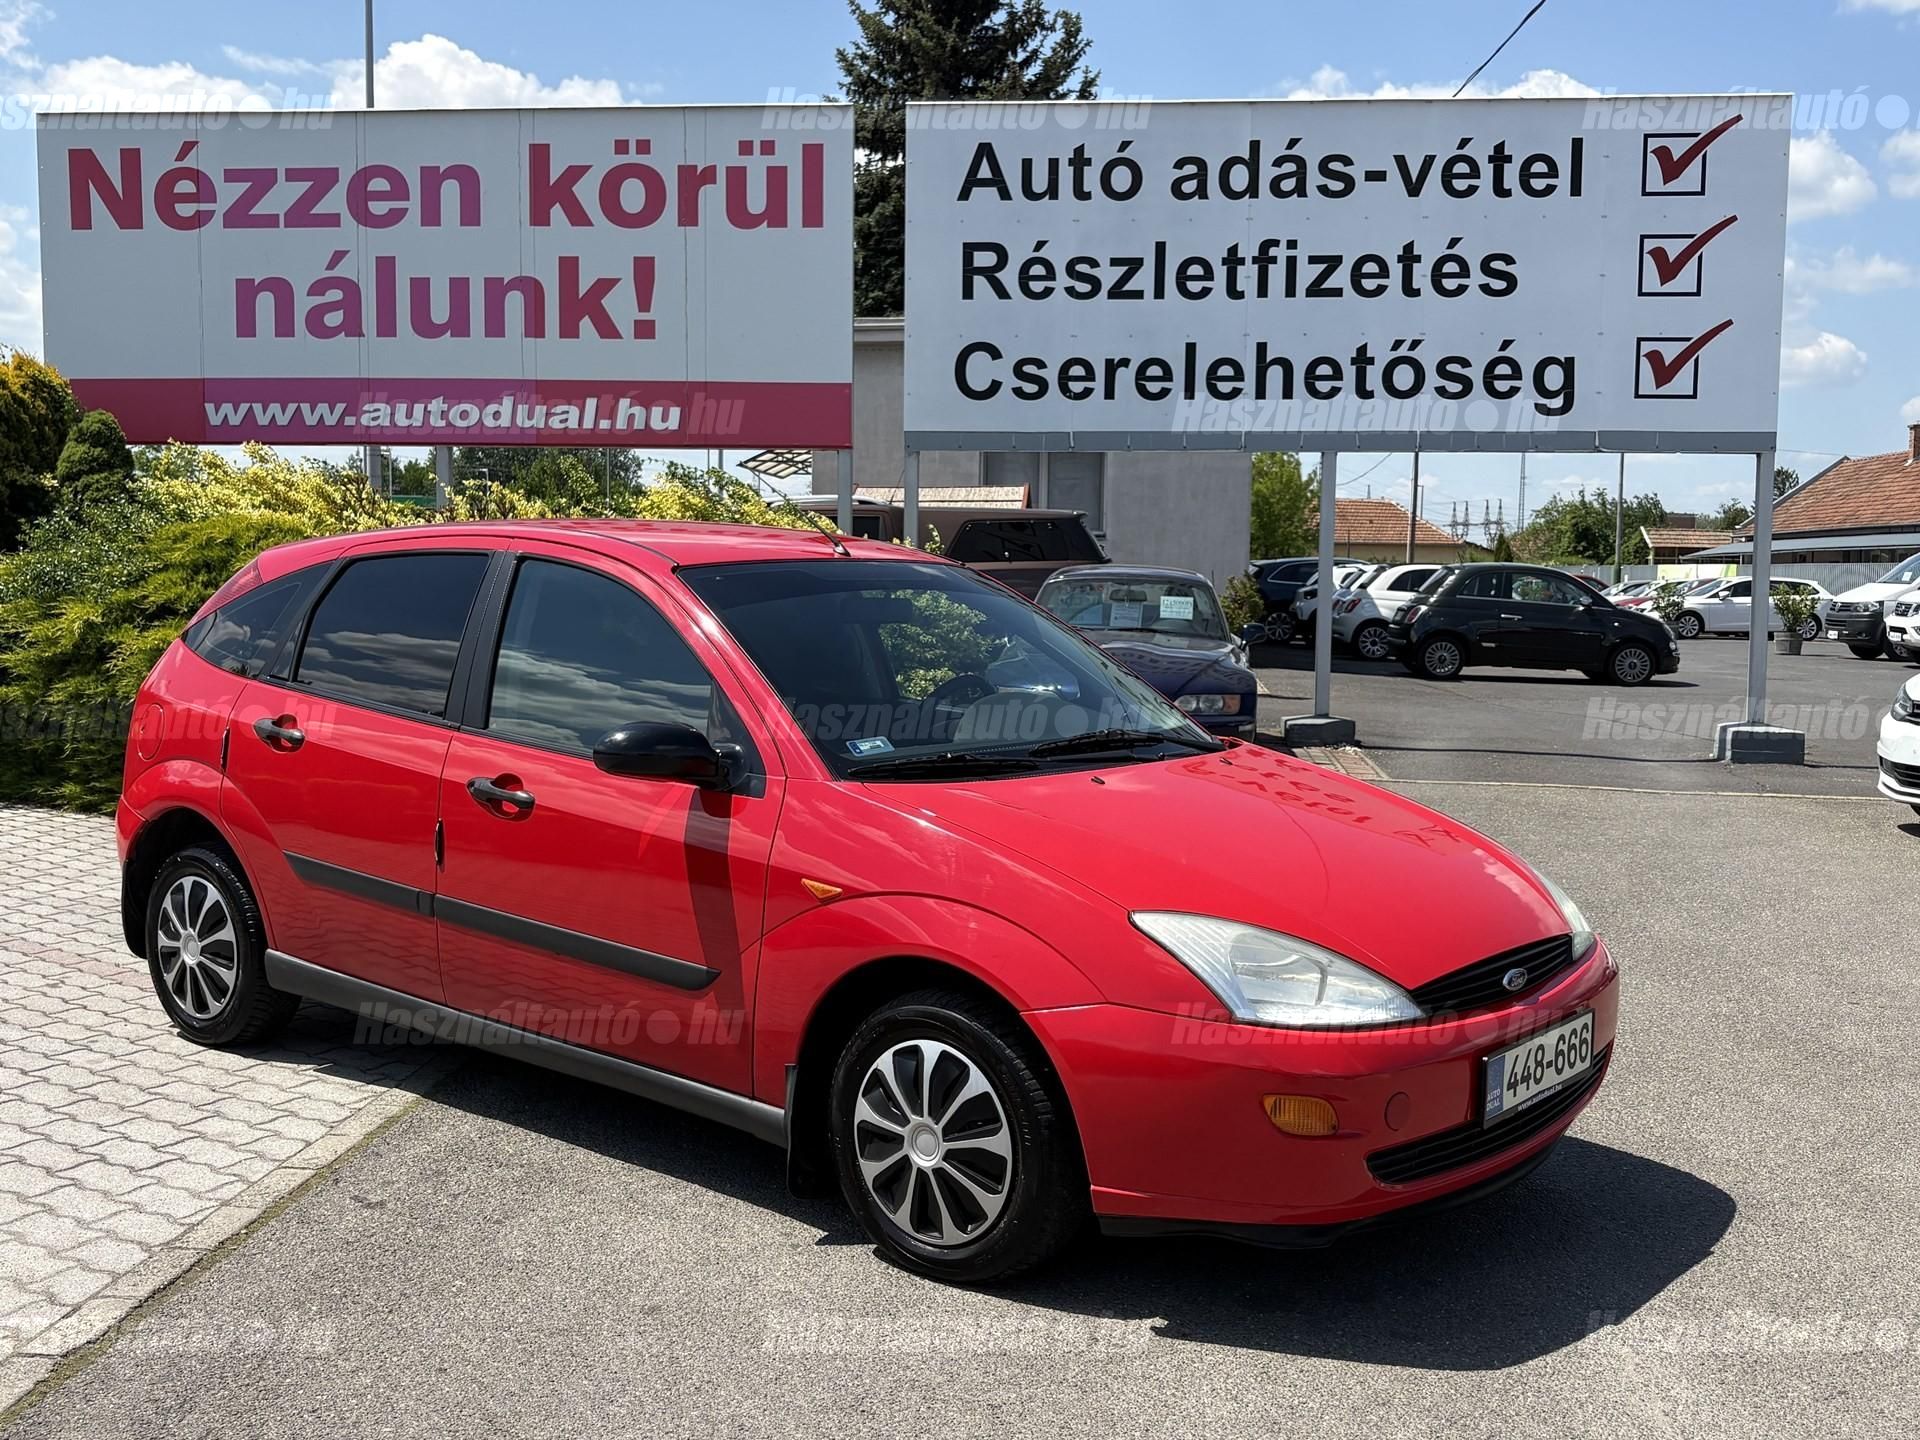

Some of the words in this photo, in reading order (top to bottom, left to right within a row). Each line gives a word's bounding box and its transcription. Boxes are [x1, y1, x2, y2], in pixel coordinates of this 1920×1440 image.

[67, 140, 481, 232] Nézzen
[529, 138, 824, 229] körül
[956, 140, 1144, 202] Autó
[1170, 136, 1584, 201] adás-vétel
[234, 250, 656, 340] nálunk!
[960, 236, 1518, 302] Részletfizetés
[205, 395, 681, 432] www.autodual.hu
[954, 338, 1576, 417] Cserelehetőség
[1506, 1021, 1590, 1098] 448-666
